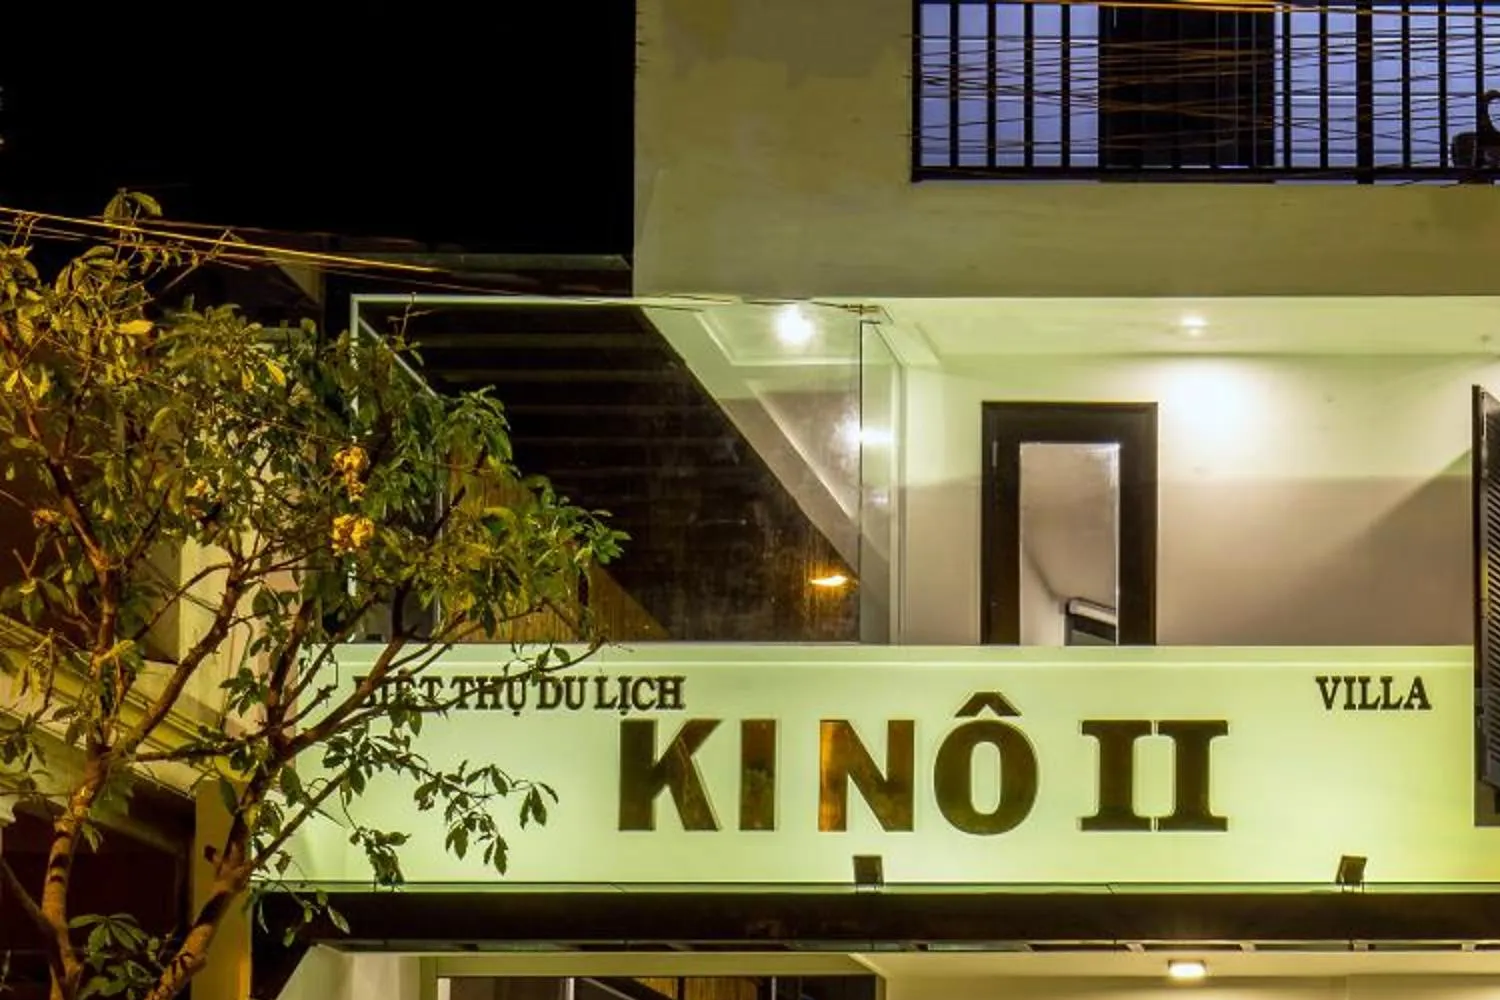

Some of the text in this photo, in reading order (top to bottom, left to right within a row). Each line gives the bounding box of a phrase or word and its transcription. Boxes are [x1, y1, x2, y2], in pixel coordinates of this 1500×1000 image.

[536, 675, 588, 711] DU
[594, 675, 686, 716] LỊCH
[1315, 675, 1433, 711] VILLA
[1080, 719, 1230, 832] II
